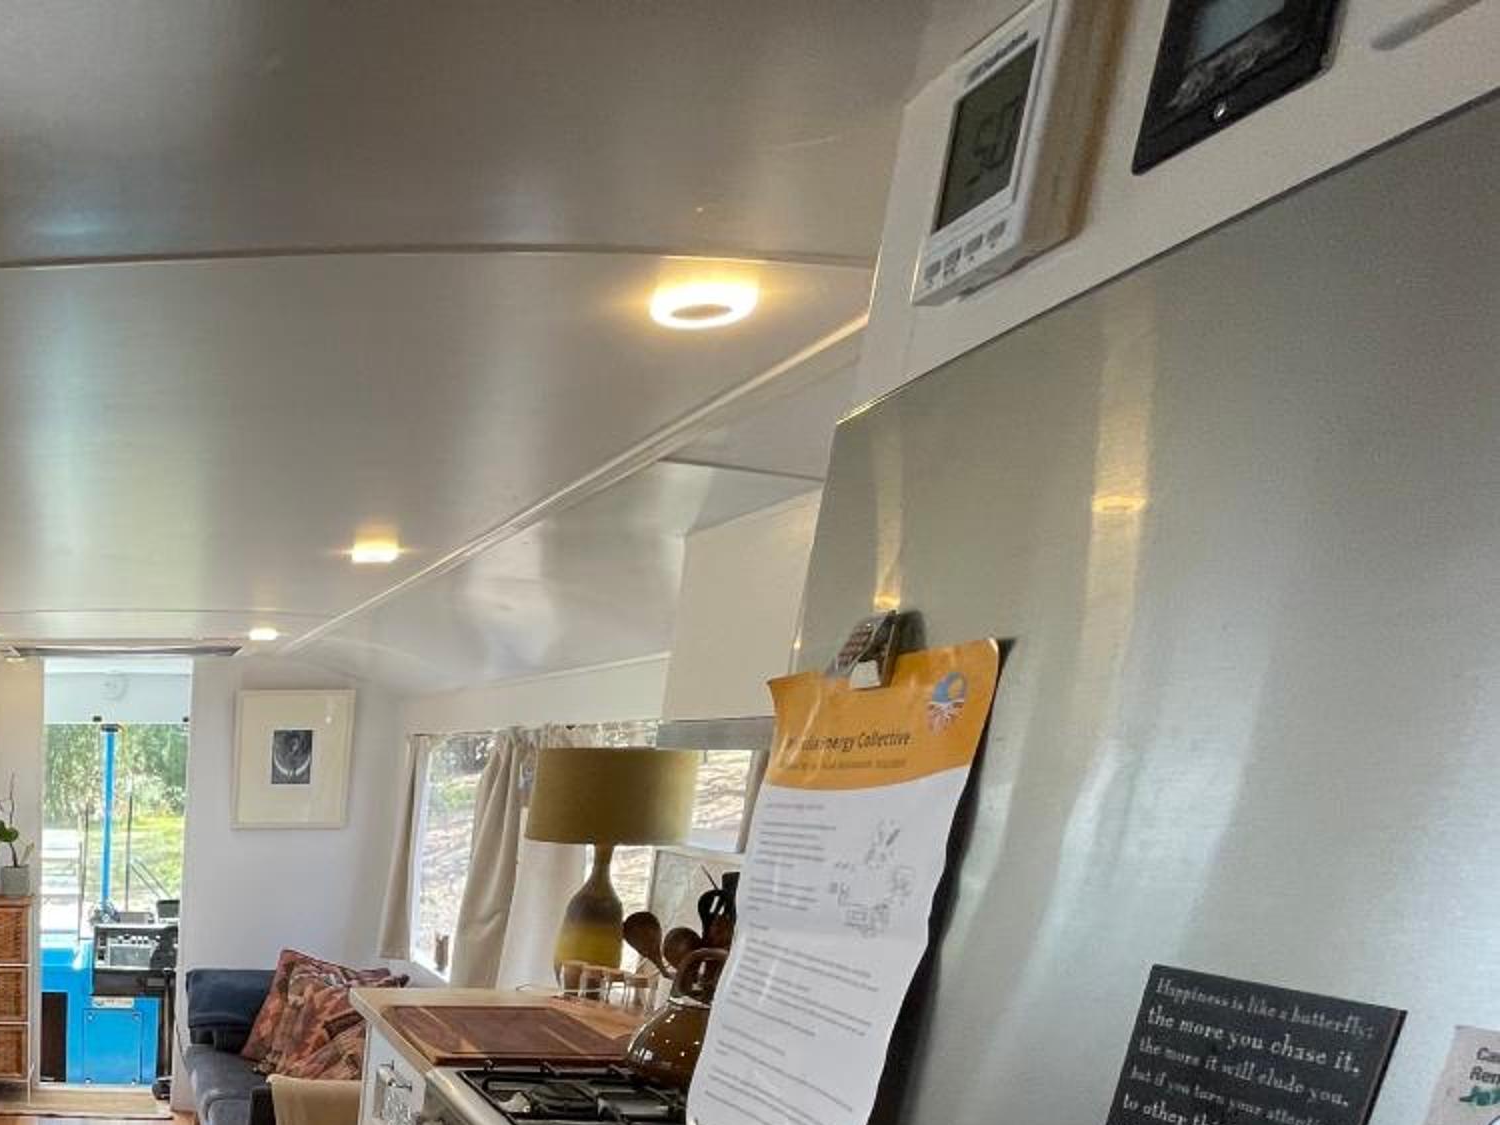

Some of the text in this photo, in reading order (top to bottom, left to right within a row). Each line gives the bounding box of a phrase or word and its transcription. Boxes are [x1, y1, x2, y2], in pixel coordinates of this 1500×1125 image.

[857, 730, 911, 748] Collective
[1156, 977, 1228, 1006] Happiness
[1230, 996, 1243, 1010] is
[1247, 995, 1277, 1017] like
[1148, 1005, 1175, 1028] the
[1179, 1020, 1224, 1040] more
[1227, 1032, 1264, 1050] you
[1271, 1033, 1327, 1065] chase
[1139, 1035, 1161, 1055] the
[1164, 1048, 1200, 1067] more
[1204, 1055, 1218, 1072] it
[1221, 1060, 1256, 1081] will
[1258, 1067, 1305, 1093] elude
[1123, 1092, 1139, 1111] to
[1194, 1083, 1224, 1105] turn
[1227, 1097, 1262, 1115] your
